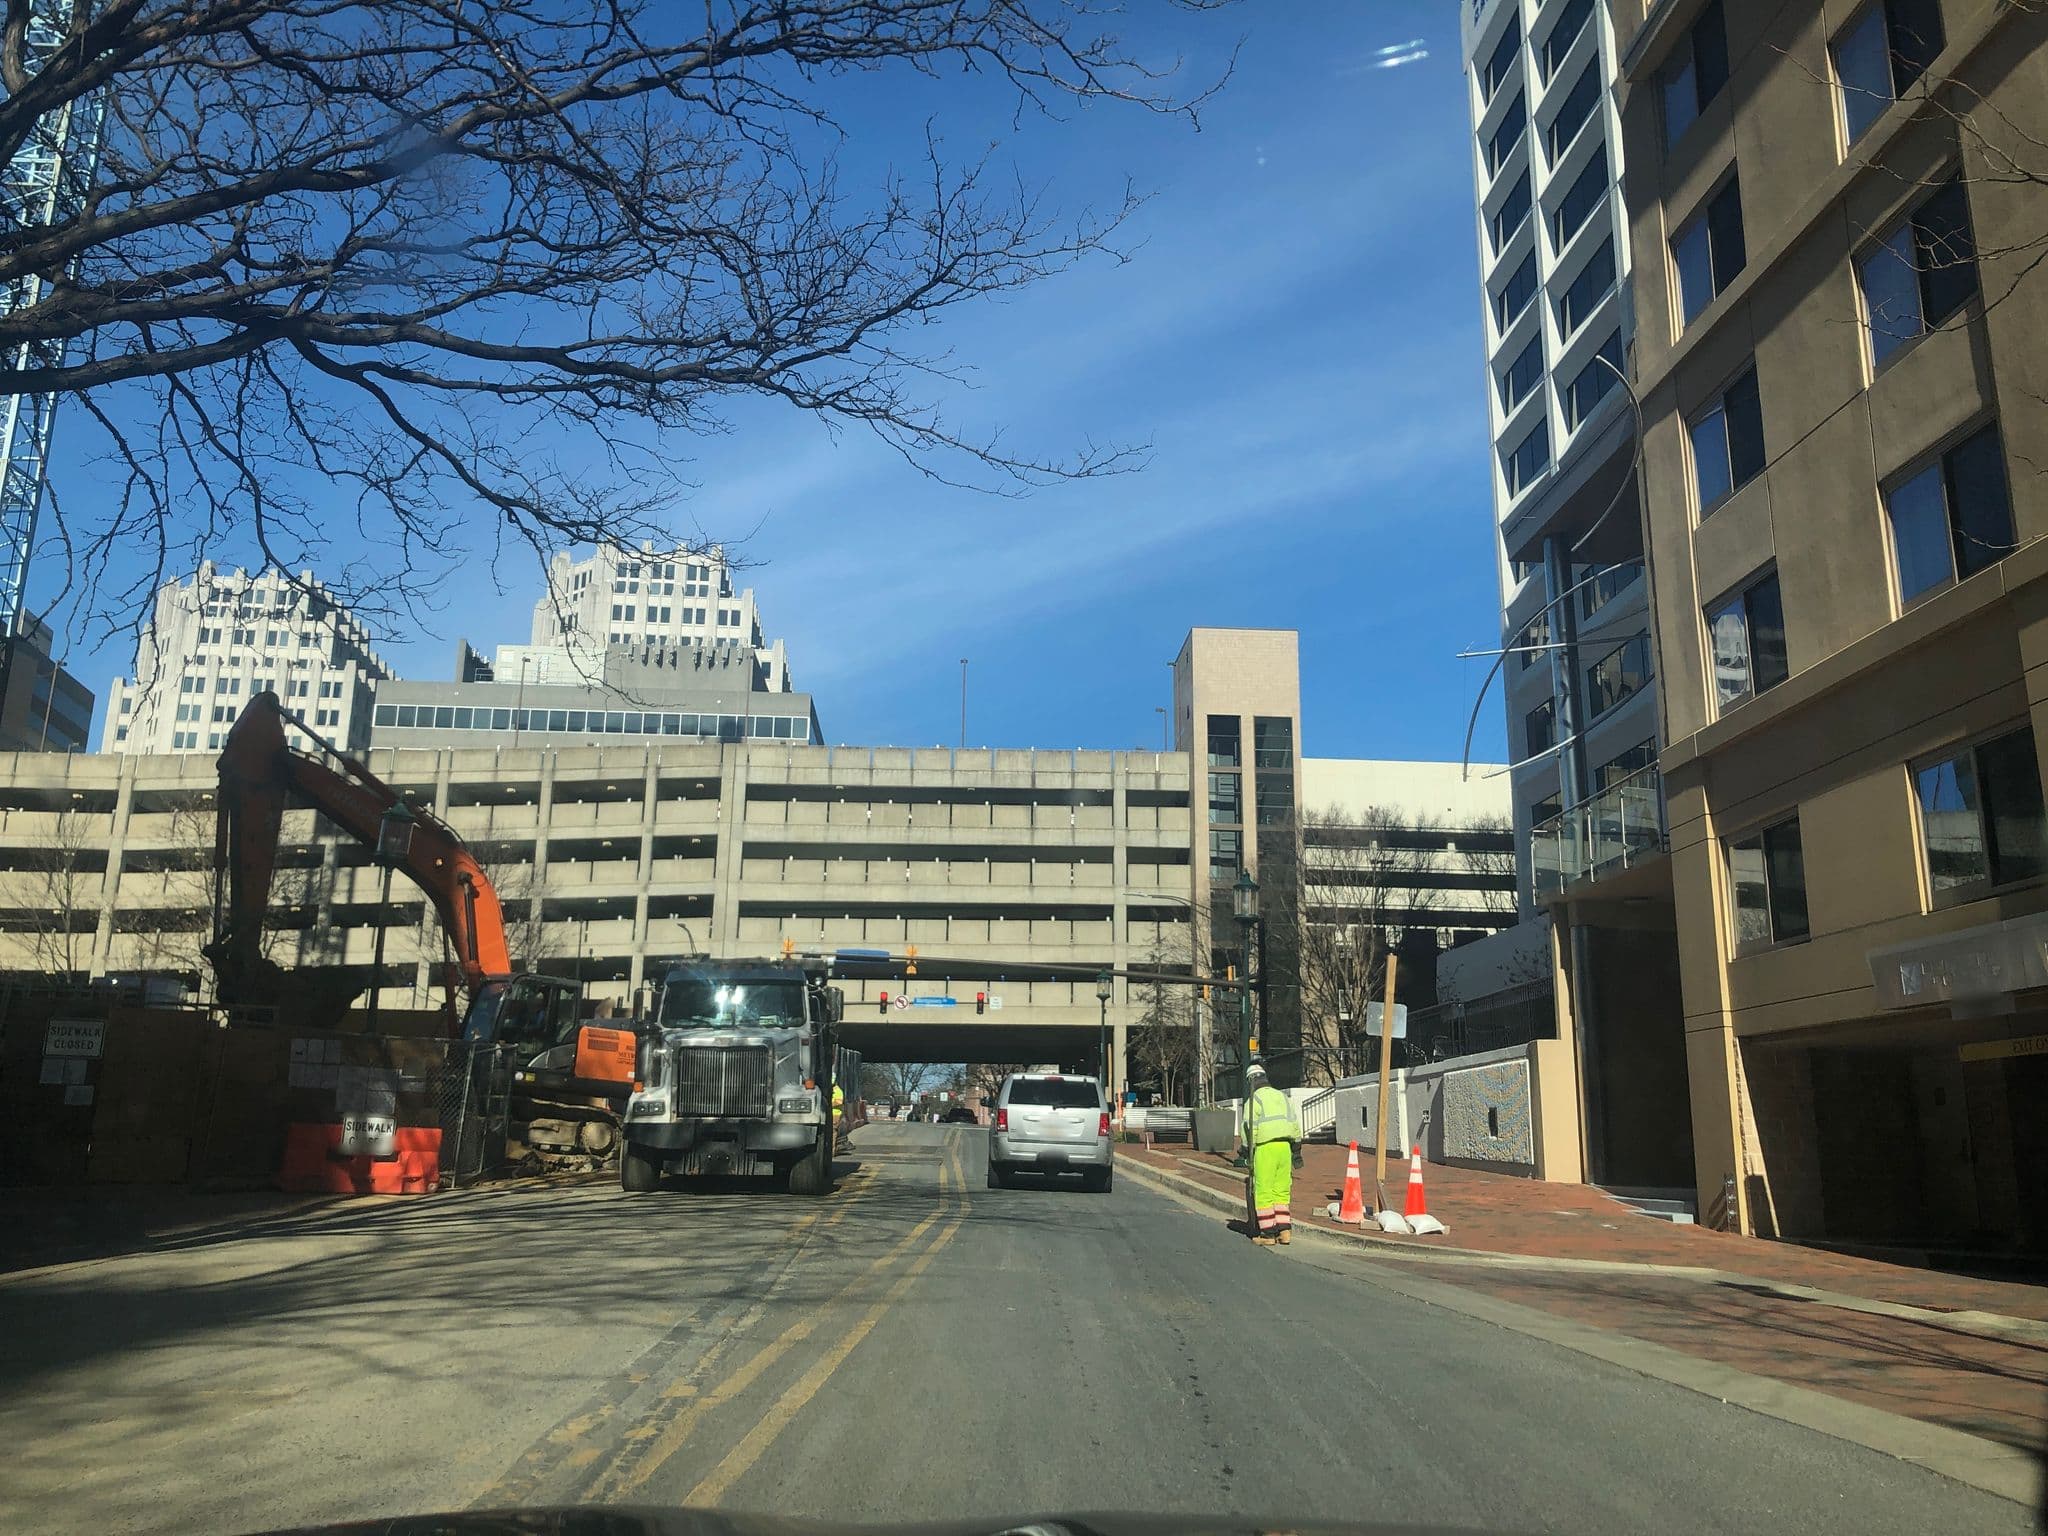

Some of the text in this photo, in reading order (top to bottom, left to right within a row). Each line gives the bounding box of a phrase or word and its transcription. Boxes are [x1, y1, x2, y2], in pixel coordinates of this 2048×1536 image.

[50, 1026, 100, 1037] SIDEWALK
[54, 1040, 94, 1049] CLOSED
[2013, 1039, 2033, 1054] EXIT
[346, 1121, 392, 1133] SIDEWALK
